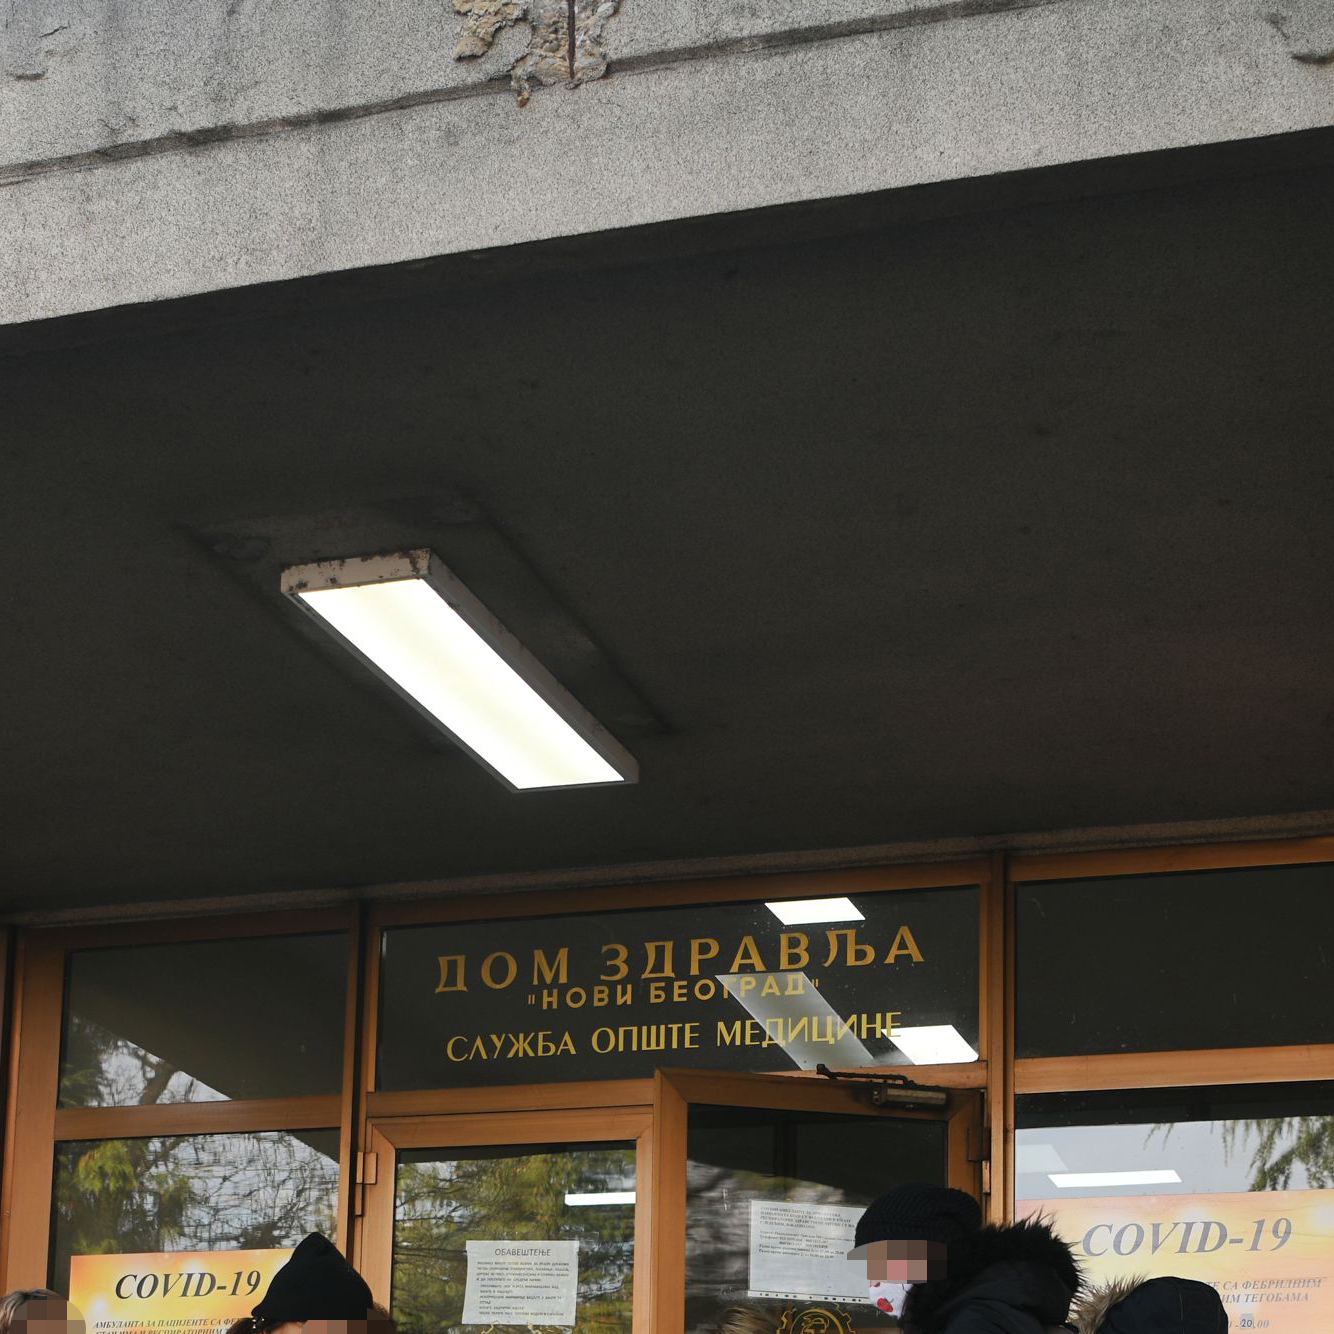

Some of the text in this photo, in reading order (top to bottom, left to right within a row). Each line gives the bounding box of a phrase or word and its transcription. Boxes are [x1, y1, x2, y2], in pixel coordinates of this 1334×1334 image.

[435, 925, 924, 994] ДОМ ЗДРАВЉА
[447, 1012, 902, 1062] СЛУЖБА ОПШТЕ МЕДИЦИНЕ
[1082, 1218, 1292, 1256] COVID-19
[494, 1248, 552, 1256] ОБАВЕШТЕЊЕ
[115, 1270, 261, 1299] COVID-19
[1242, 1279, 1322, 1290] ФЕБРИЛНИМ
[1245, 1293, 1308, 1303] ТЕГОБАМА
[94, 1321, 144, 1329] АМБУЛАНТА
[146, 1320, 156, 1328] ЗА
[158, 1319, 208, 1327] ПАЦИЈЕНТЕ
